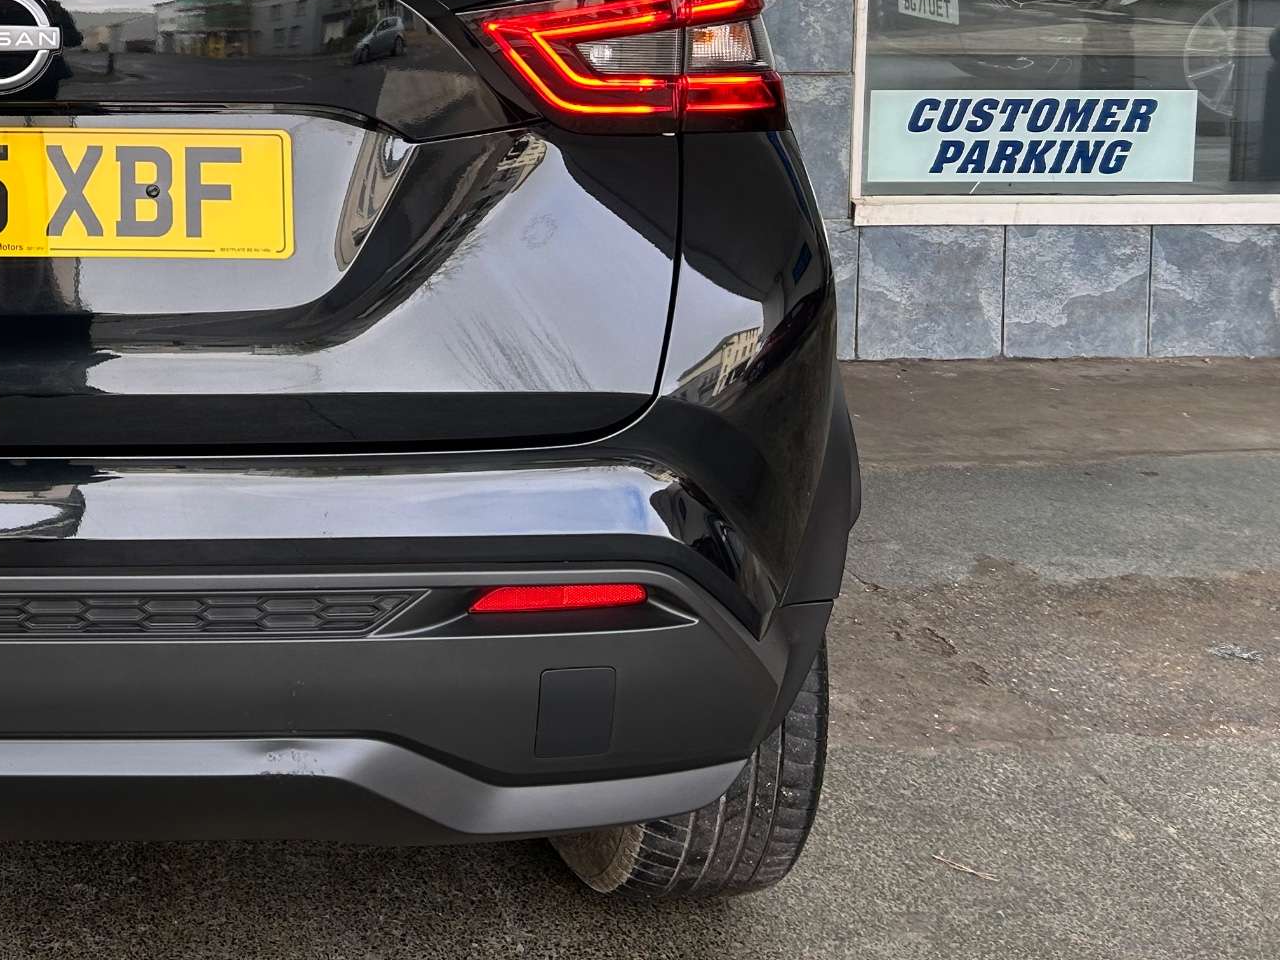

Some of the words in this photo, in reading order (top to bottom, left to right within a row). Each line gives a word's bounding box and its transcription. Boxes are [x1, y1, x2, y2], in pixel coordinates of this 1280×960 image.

[906, 97, 1159, 133] CUSTOMER
[928, 139, 1134, 175] PARKING
[45, 144, 243, 239] XBF
